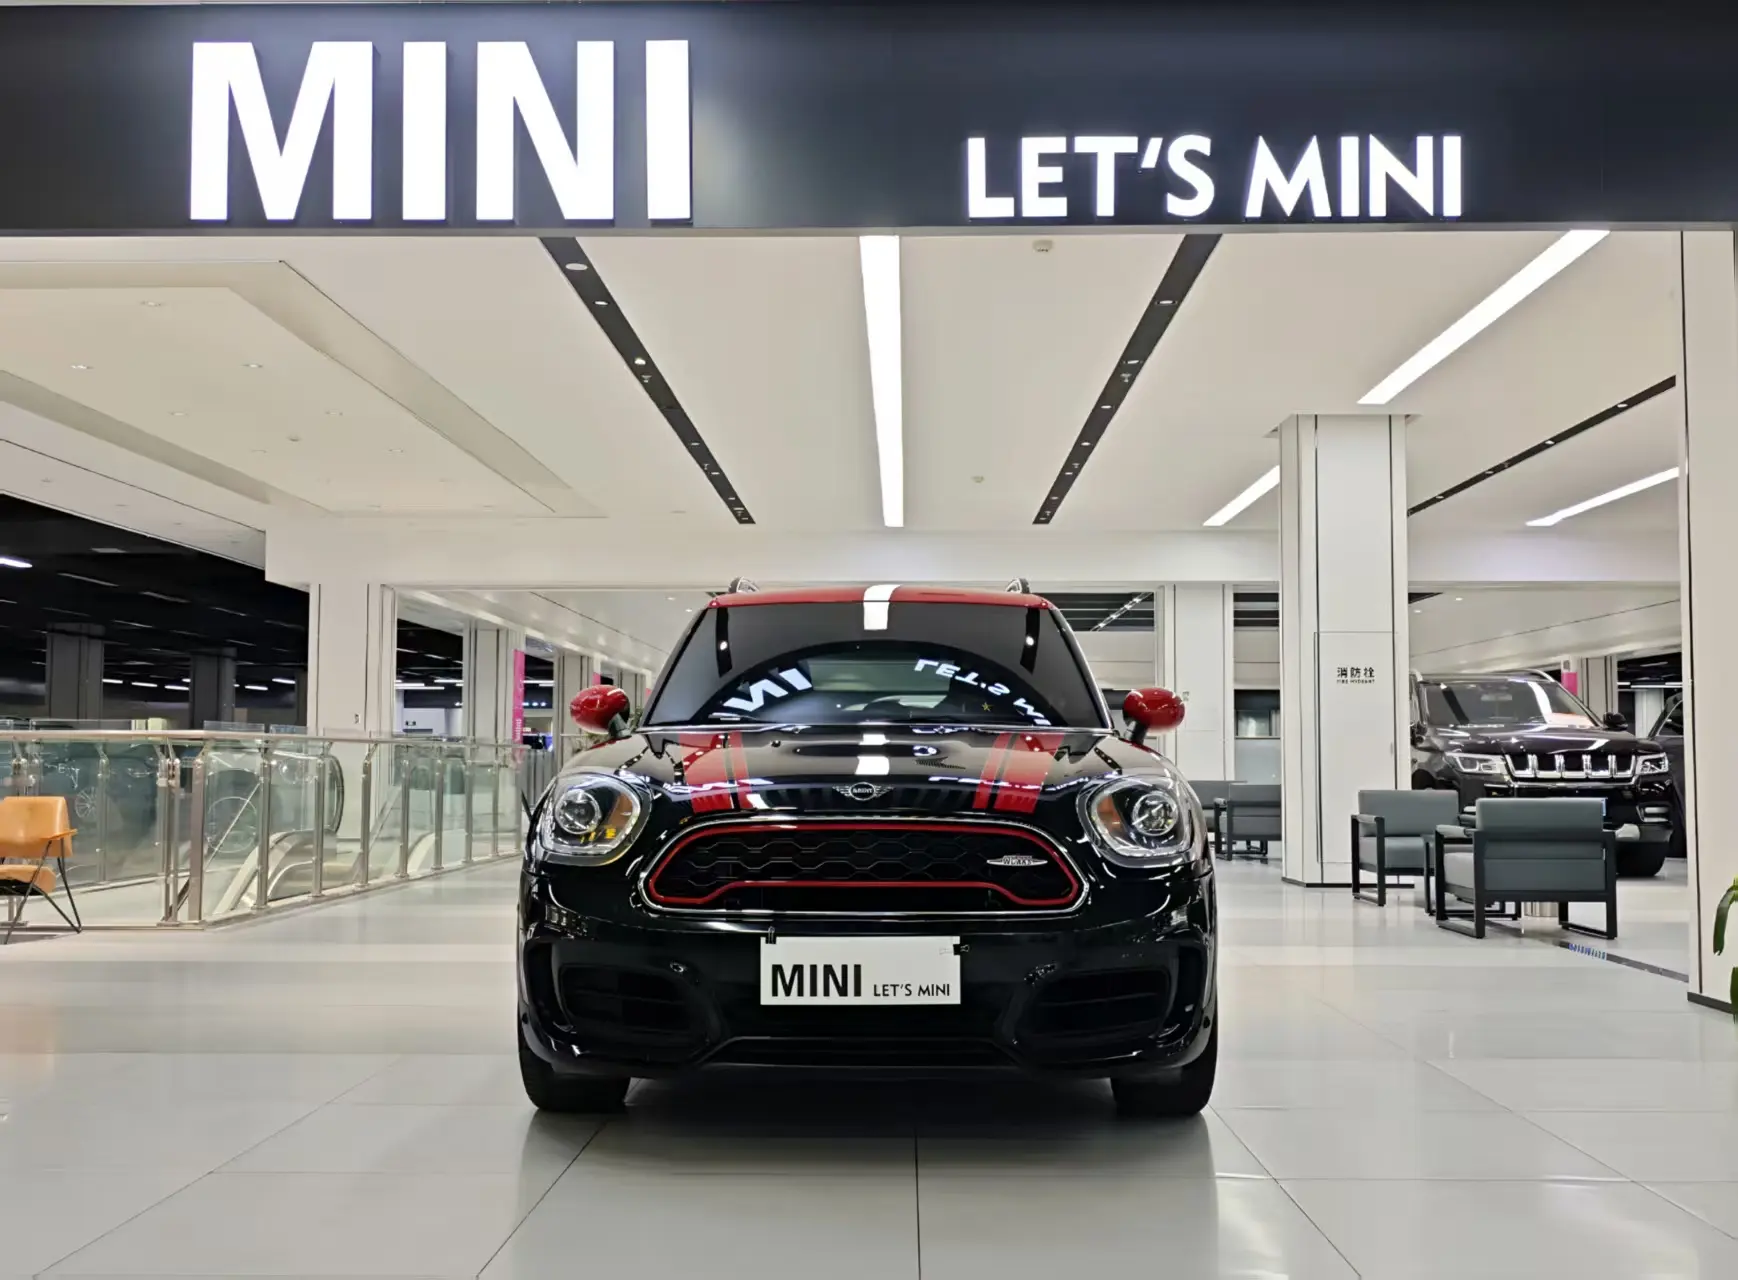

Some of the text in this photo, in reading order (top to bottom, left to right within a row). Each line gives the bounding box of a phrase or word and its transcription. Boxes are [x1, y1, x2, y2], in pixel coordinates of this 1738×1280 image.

[190, 40, 692, 221] MINI
[967, 134, 1463, 218] LET'S MINI
[1336, 666, 1375, 678] 消防栓
[772, 964, 950, 997] MINI LET'S MINI
